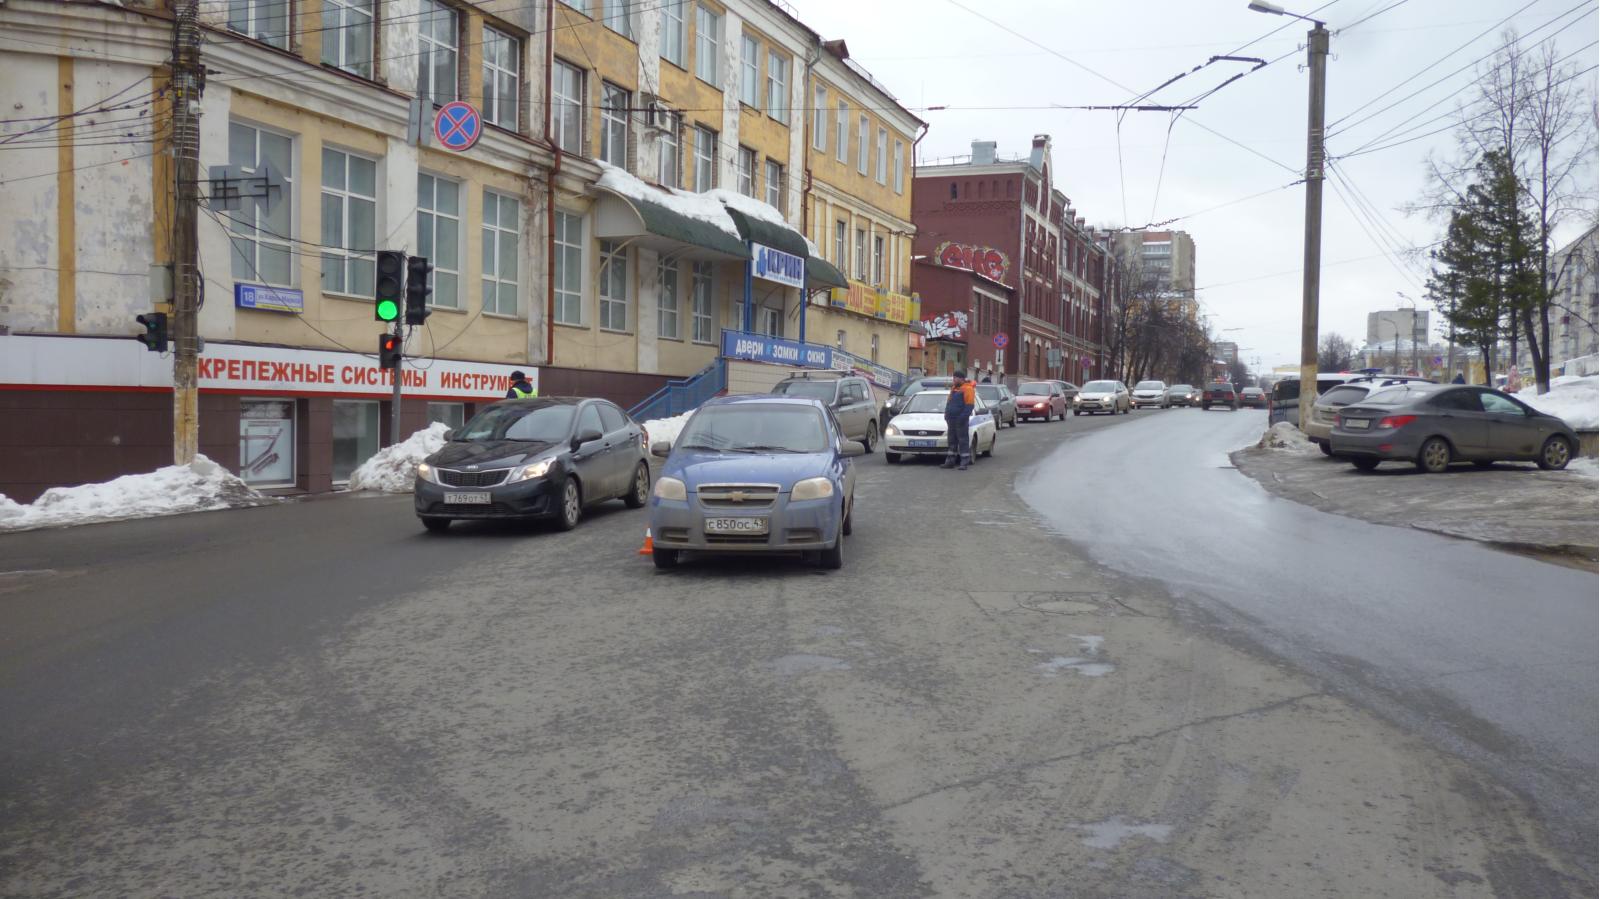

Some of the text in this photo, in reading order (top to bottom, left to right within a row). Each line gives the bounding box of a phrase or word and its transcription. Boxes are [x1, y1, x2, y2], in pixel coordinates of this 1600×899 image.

[243, 291, 254, 302] 18
[772, 344, 799, 361] замки
[806, 350, 826, 364] окна
[198, 357, 335, 384] КРЕПЕЖНЫЕ
[753, 519, 764, 529] 43
